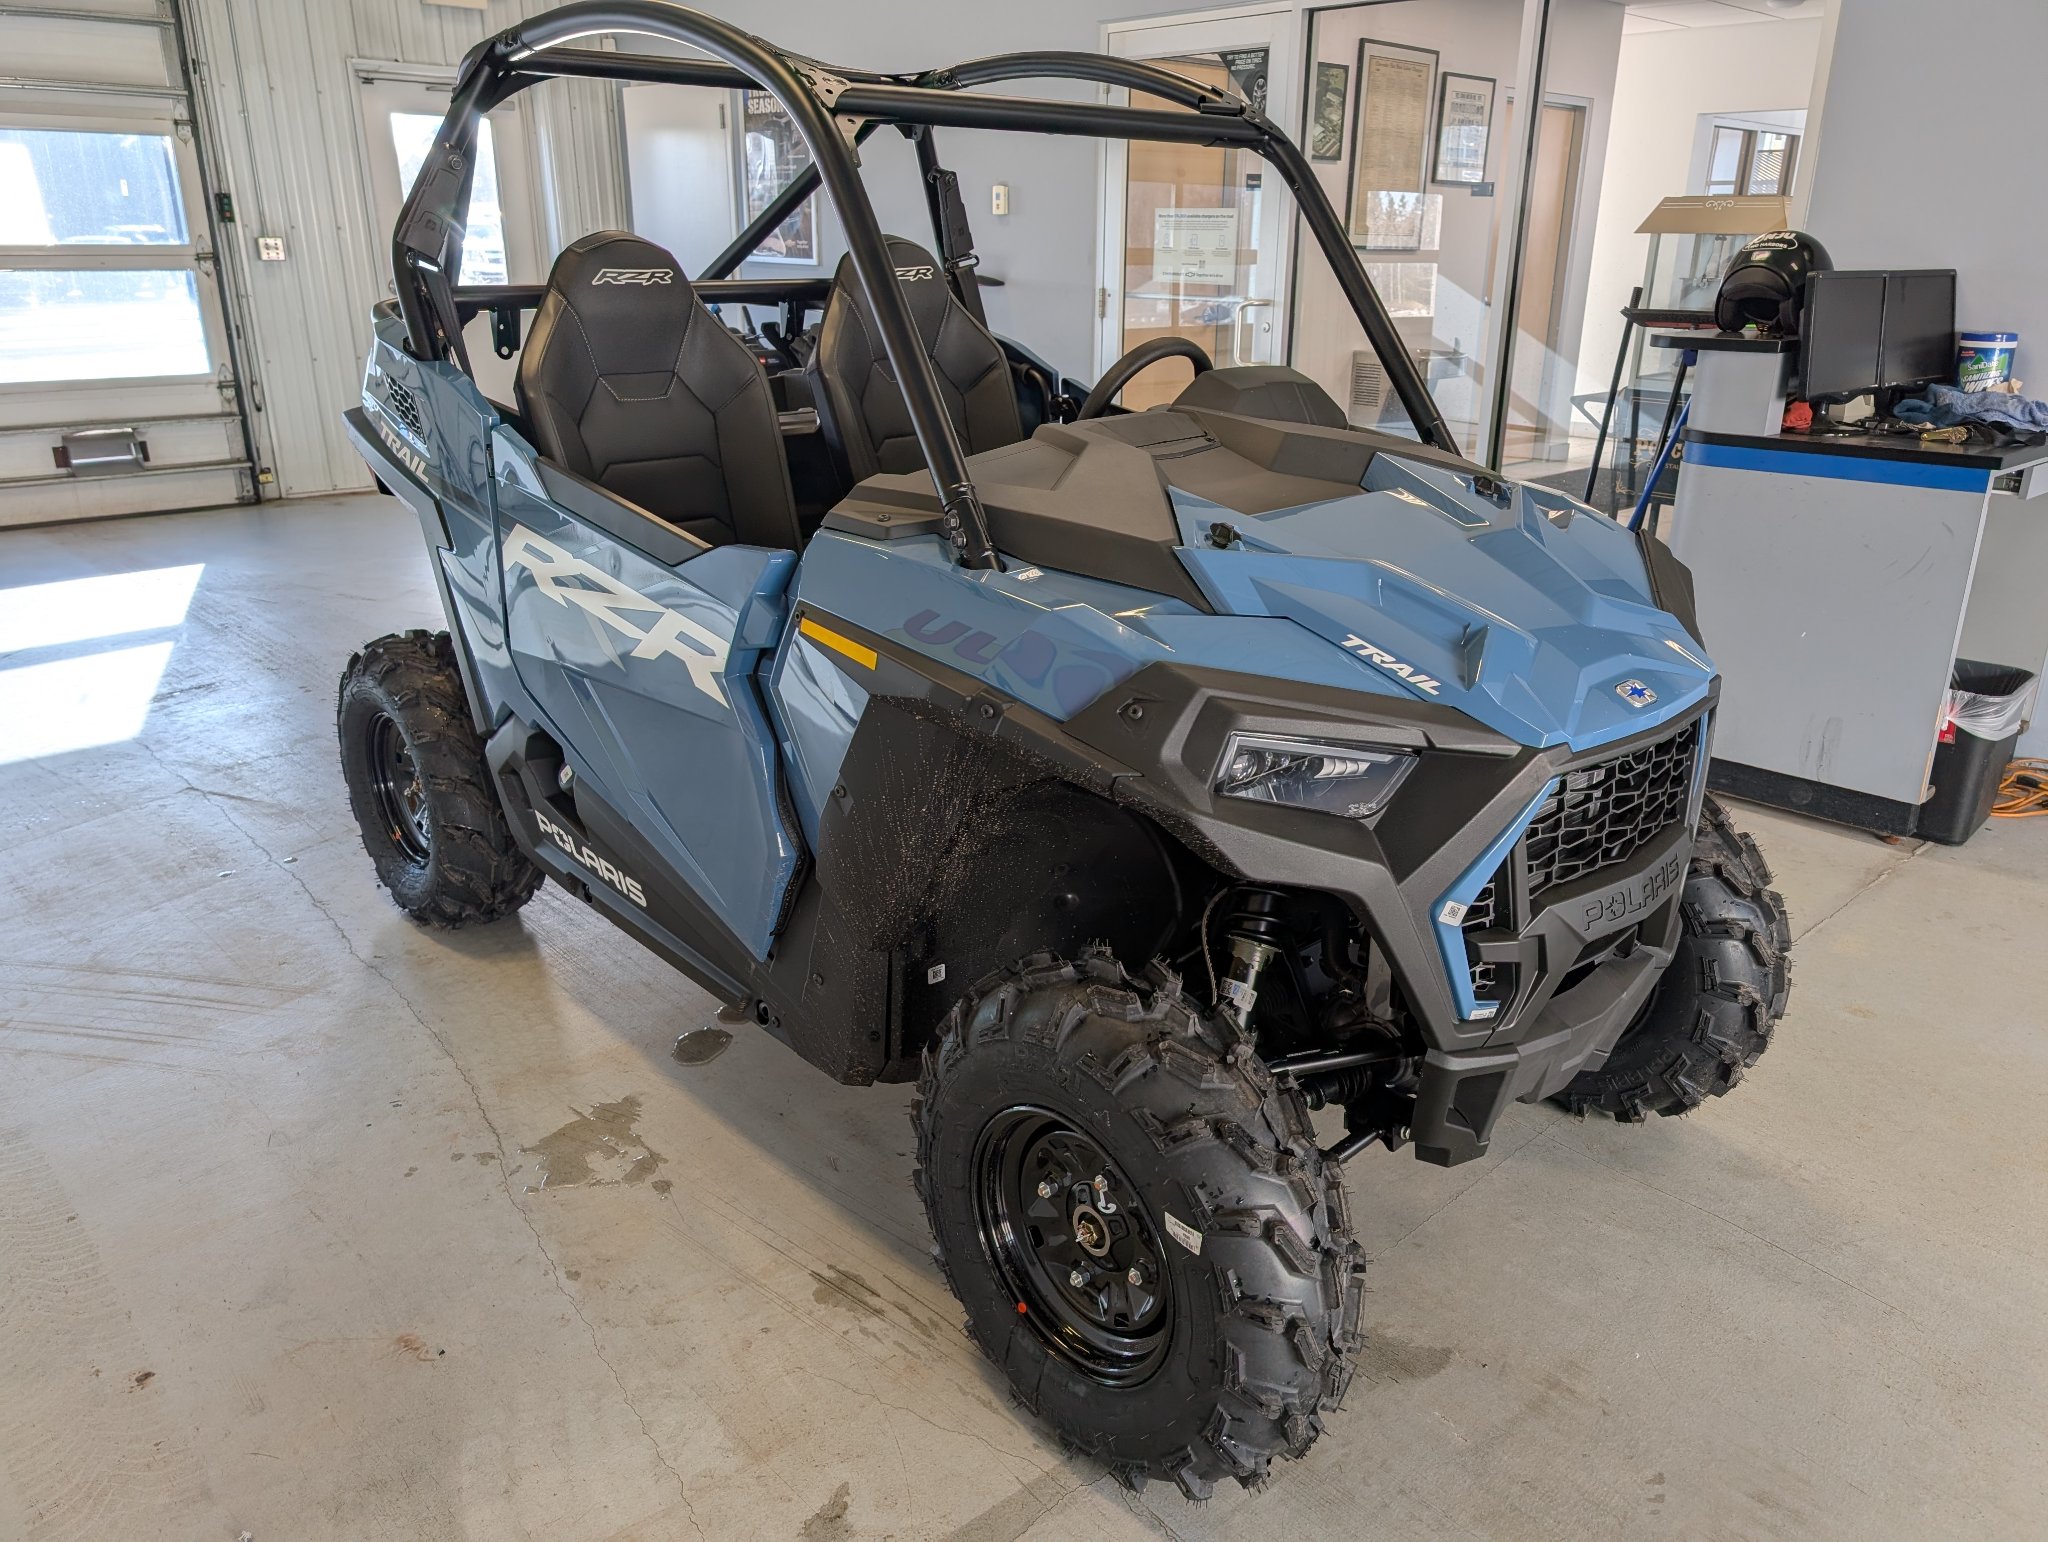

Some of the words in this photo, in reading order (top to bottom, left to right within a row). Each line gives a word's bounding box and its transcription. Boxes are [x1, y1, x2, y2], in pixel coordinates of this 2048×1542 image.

[592, 268, 674, 286] RZR
[894, 265, 934, 282] ZR
[380, 420, 430, 484] TRAIL
[502, 523, 733, 710] RZR
[1340, 633, 1442, 696] TRAIL
[534, 809, 648, 908] POLARIS
[1582, 851, 1681, 932] POLARIS
